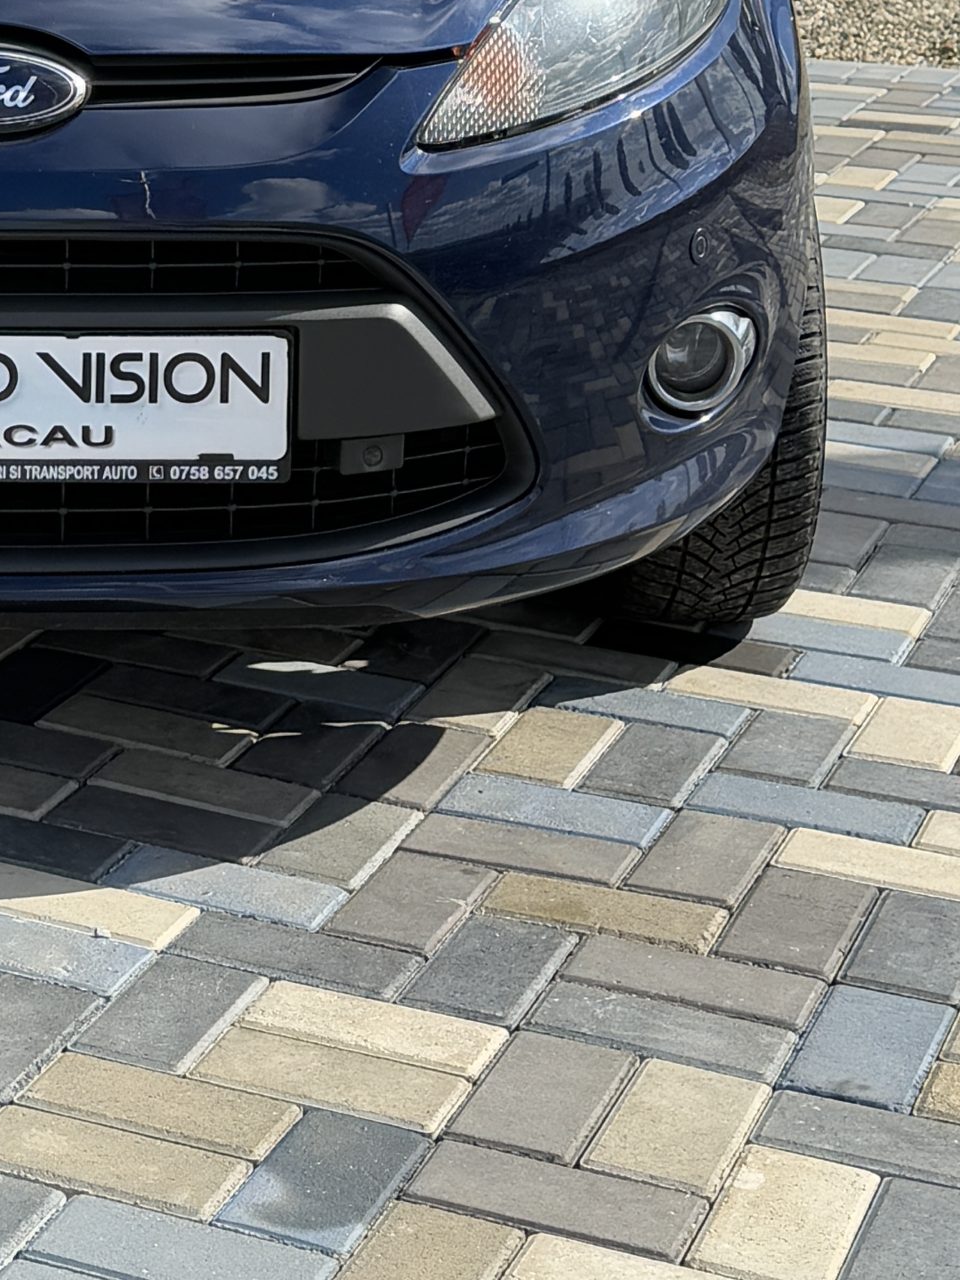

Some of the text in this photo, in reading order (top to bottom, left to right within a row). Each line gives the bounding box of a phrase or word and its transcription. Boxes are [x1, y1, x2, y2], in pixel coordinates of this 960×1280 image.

[36, 352, 271, 404] VISION
[9, 465, 22, 480] SI
[24, 465, 101, 480] TRANSPORT
[102, 465, 138, 480] AUTO
[170, 465, 278, 480] 0758 657 045
